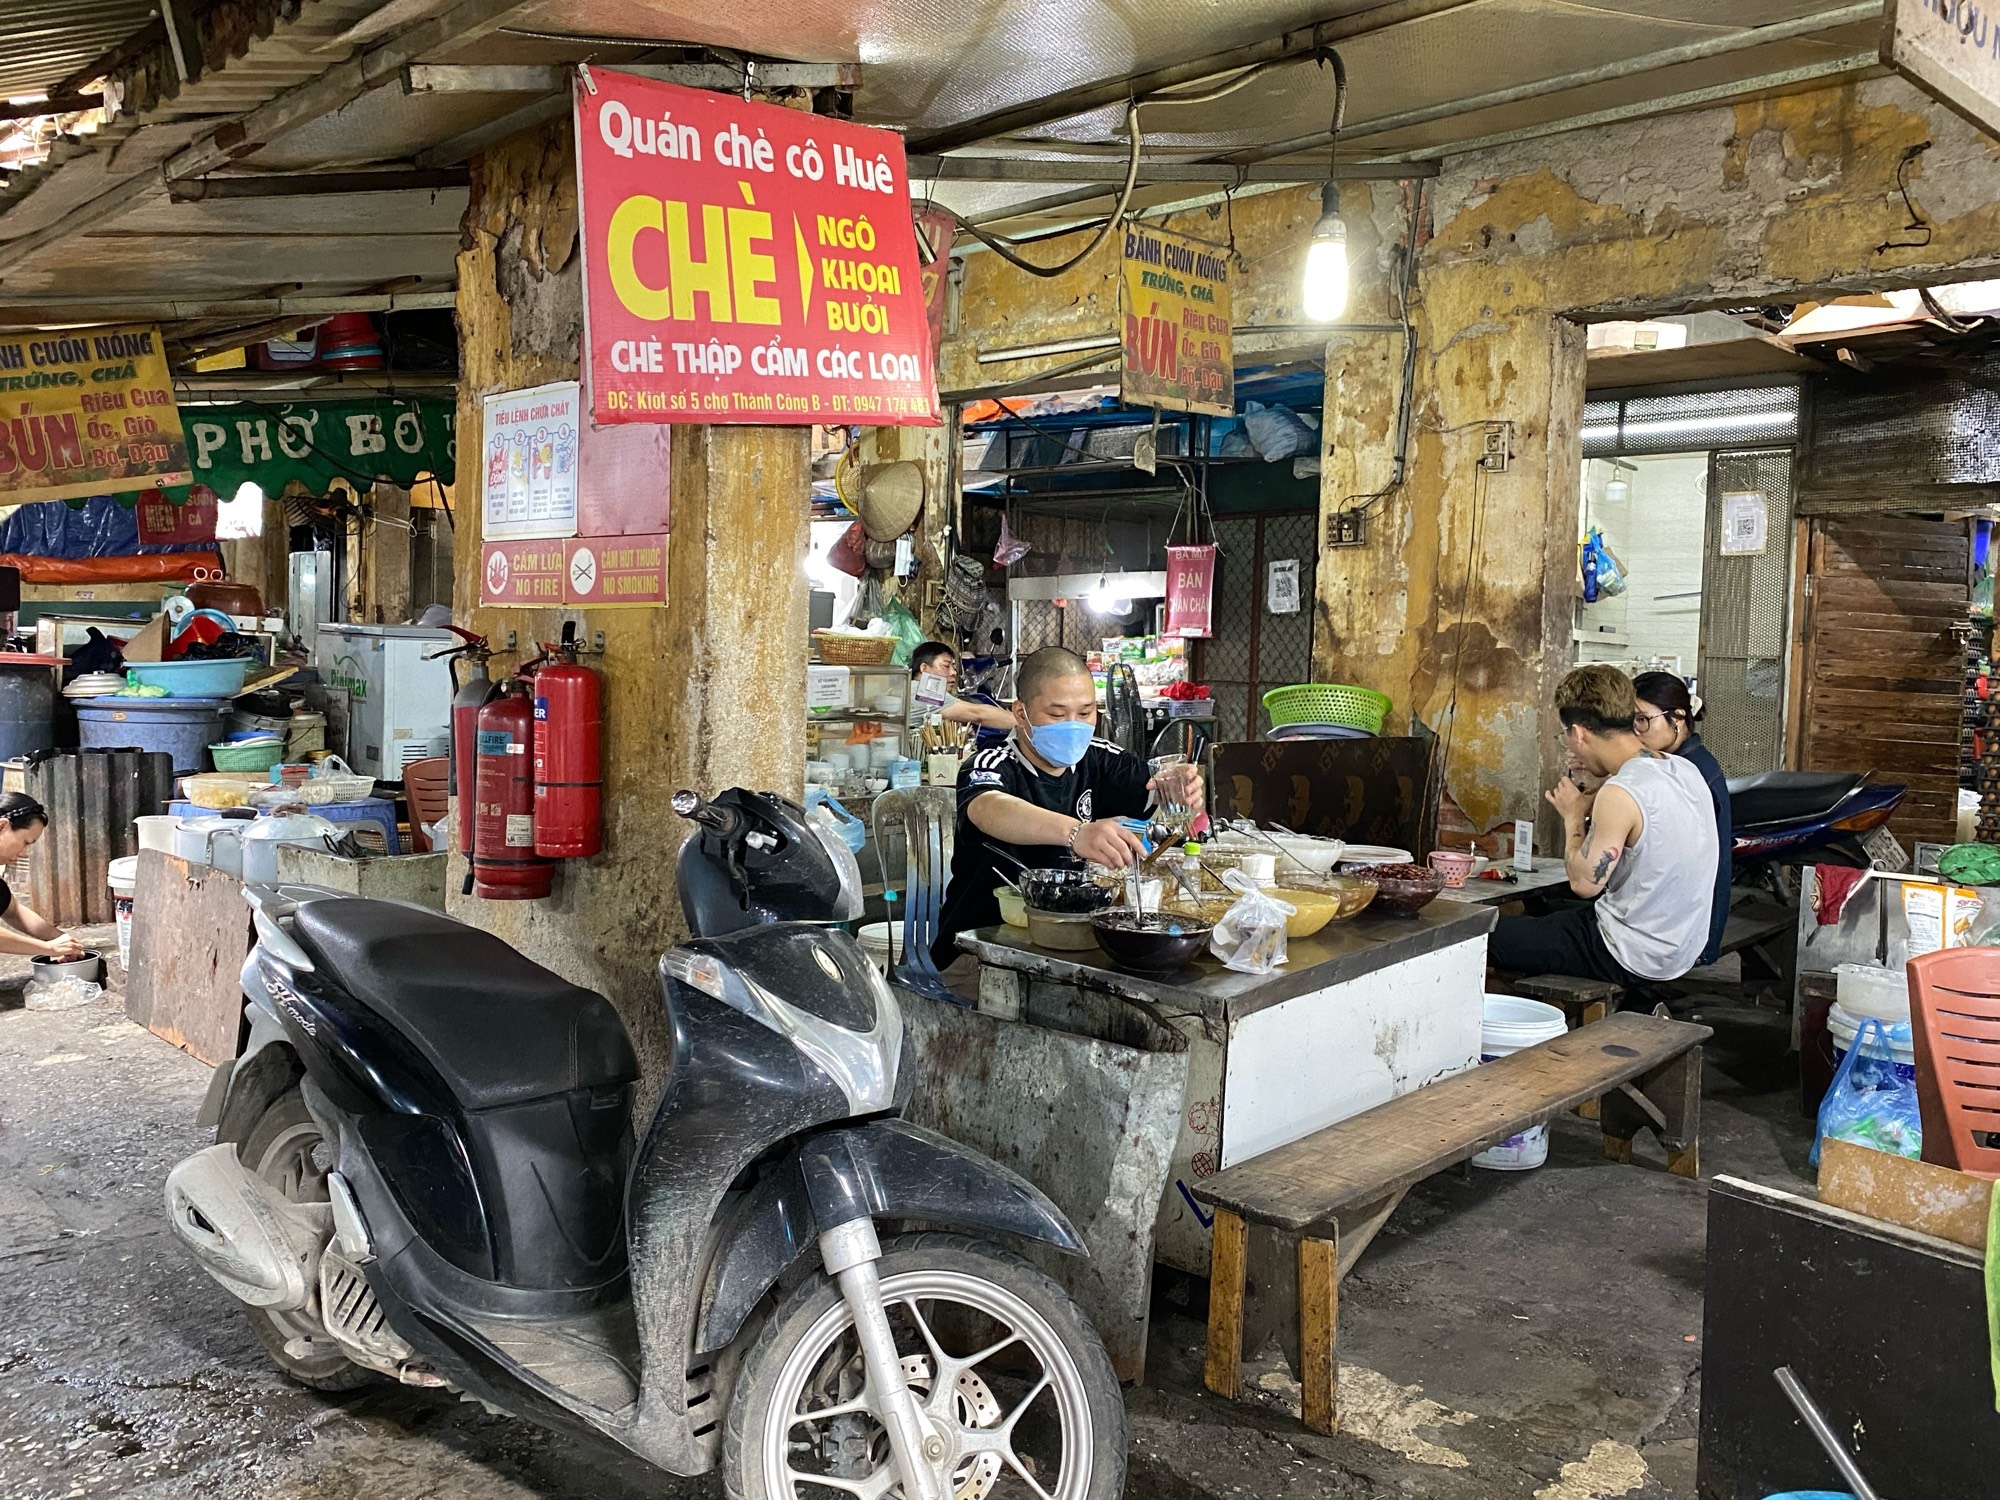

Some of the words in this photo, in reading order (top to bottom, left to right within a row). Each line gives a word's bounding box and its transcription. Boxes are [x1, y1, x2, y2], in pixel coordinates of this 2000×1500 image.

[600, 101, 701, 161] Quán
[714, 123, 774, 173] chè
[786, 139, 824, 181] cô
[835, 143, 894, 195] Huê
[817, 214, 876, 251] NGÔ
[607, 181, 782, 326] CHÈ
[1124, 230, 1162, 266] BÁNH
[1164, 240, 1195, 276] CUỐN
[1195, 251, 1227, 283] NÓNG
[821, 258, 901, 296] KHOAI
[1141, 270, 1187, 297] TRỨNG,
[826, 294, 890, 335] BƯỞI
[1182, 307, 1205, 331] Riêu
[1207, 313, 1229, 337] Cua
[29, 331, 92, 367] CUỐN
[93, 329, 156, 361] NÓNG
[1126, 302, 1178, 381] BÚN
[1181, 331, 1199, 362] Ốc,
[1201, 339, 1221, 361] Giò
[90, 360, 139, 384] CHẢ
[610, 335, 664, 374] CHÈ
[672, 338, 742, 382] THẬP
[750, 333, 810, 378] CẨM
[816, 344, 863, 380] CÁC
[870, 354, 921, 388] LOẠI
[1201, 367, 1224, 392] Đậu
[80, 391, 128, 414] Riêu
[130, 387, 170, 408] Cua
[608, 391, 633, 410] ĐC:
[637, 391, 666, 410] Kiot
[670, 389, 687, 410] số
[691, 392, 699, 410] 5
[703, 392, 729, 414] chợ
[732, 391, 772, 411] Thành
[776, 392, 809, 413] Công
[812, 394, 821, 410] B
[832, 394, 851, 411] ĐT:
[853, 395, 882, 412] 0947
[885, 396, 907, 412] 174
[86, 414, 121, 441] Ốc,
[124, 415, 158, 438] Giò
[192, 403, 319, 469] PHỞ
[346, 399, 425, 457] BÒ
[92, 447, 126, 469] Bò,
[129, 442, 169, 468] Đậu
[516, 578, 530, 596] NO
[534, 578, 558, 596] FIRE
[603, 576, 615, 595] NO
[618, 574, 659, 595] SMOKING
[1178, 568, 1203, 588] BÁN
